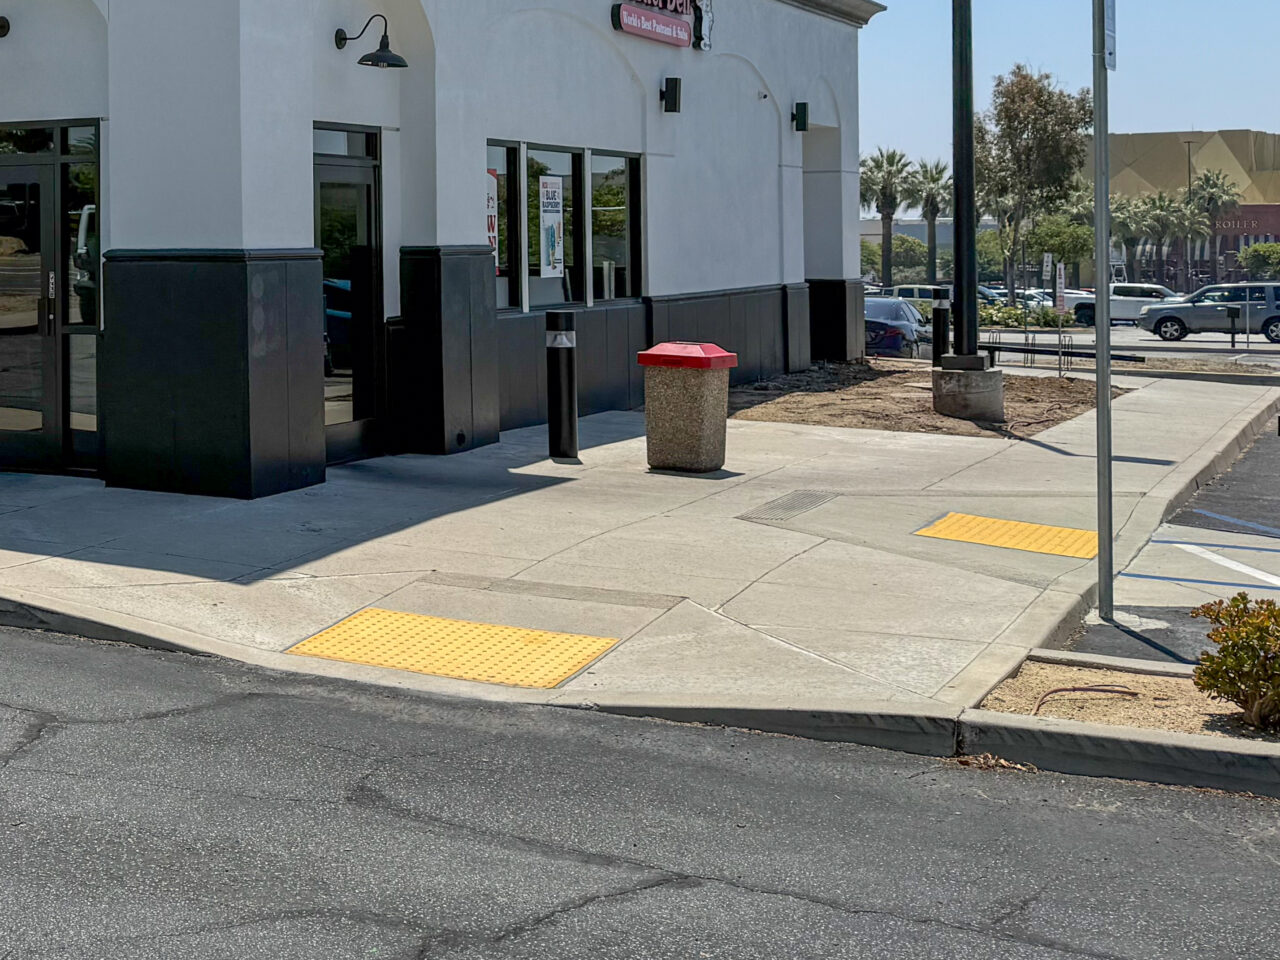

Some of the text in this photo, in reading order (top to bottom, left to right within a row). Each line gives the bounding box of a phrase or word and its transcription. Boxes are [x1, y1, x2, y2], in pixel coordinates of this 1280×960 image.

[641, 15, 652, 31] Best
[677, 26, 689, 40] Subs
[1215, 220, 1259, 229] ROILER
